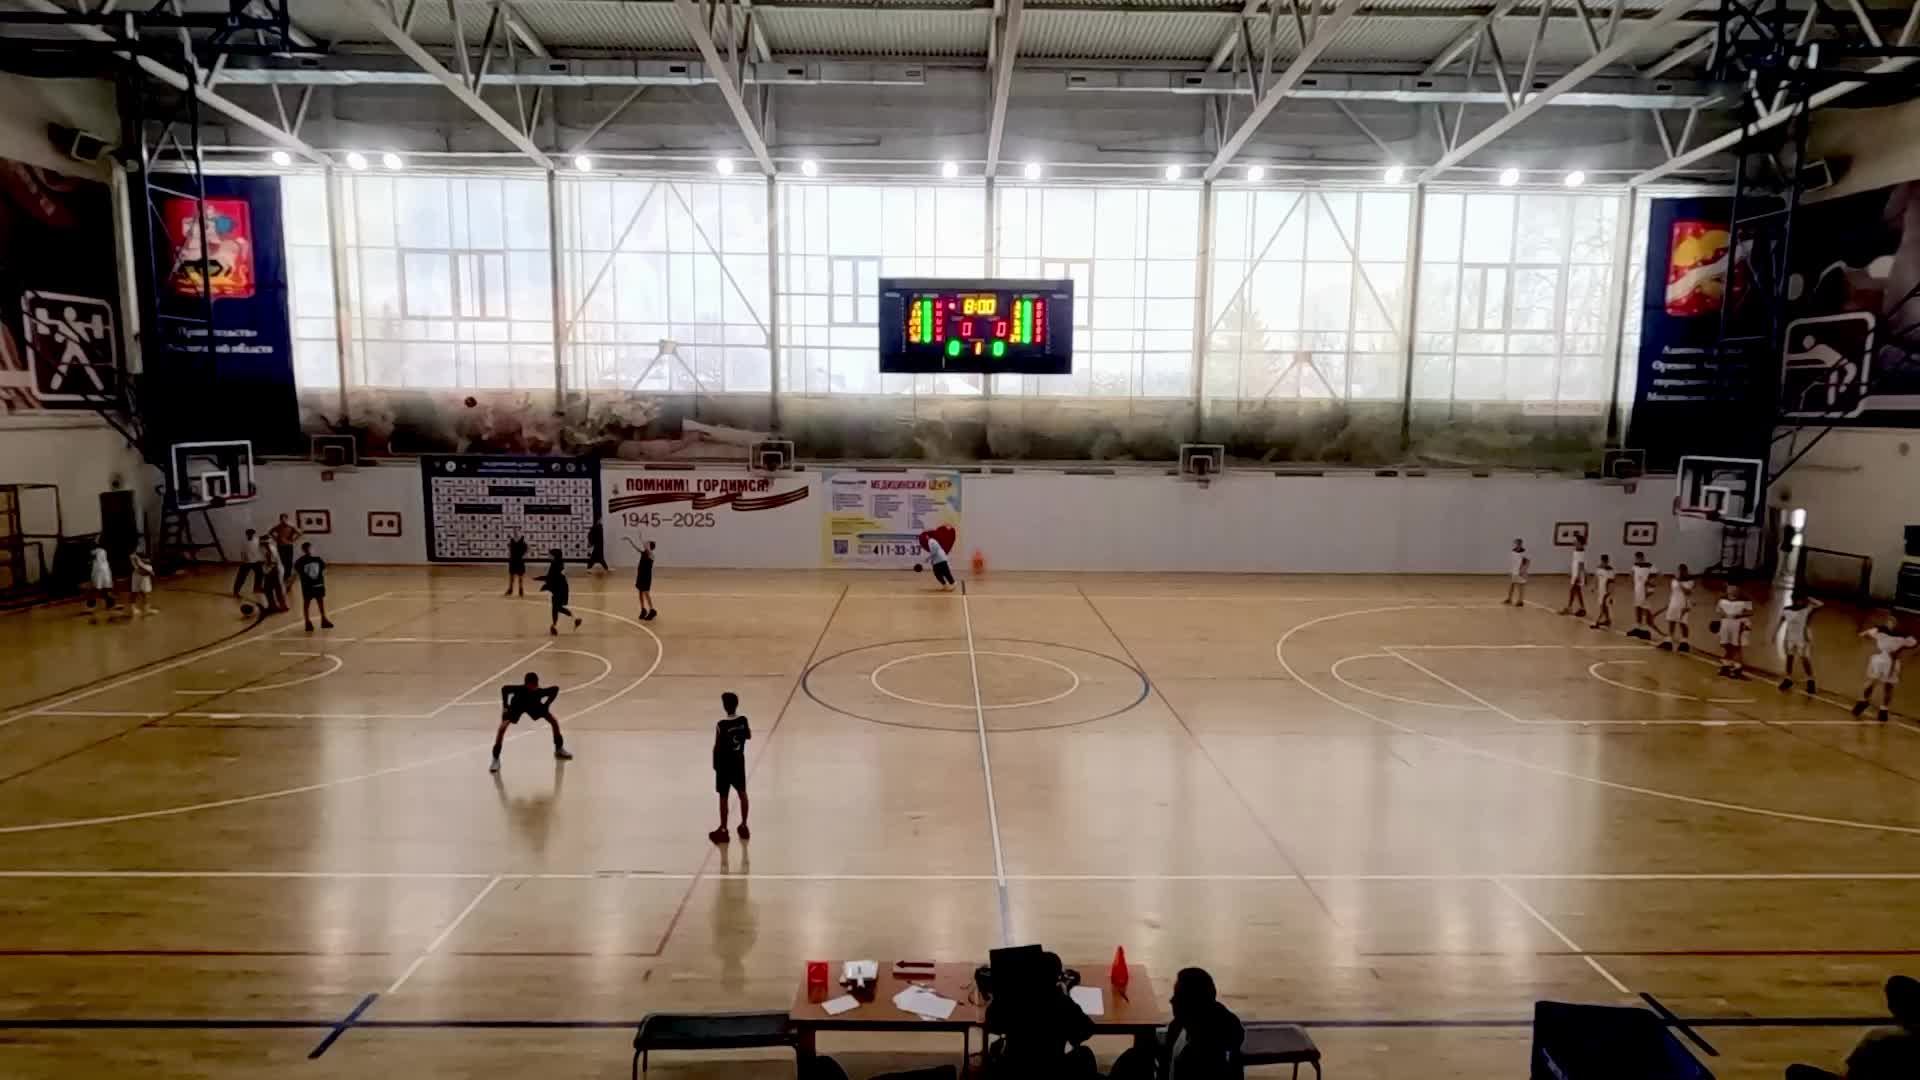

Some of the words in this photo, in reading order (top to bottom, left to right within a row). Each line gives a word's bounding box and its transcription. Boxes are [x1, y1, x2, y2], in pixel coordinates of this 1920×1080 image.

[963, 298, 996, 315] 8:00
[962, 322, 972, 336] 0
[996, 321, 1006, 337] 0
[626, 478, 689, 492] ПОМНИМ!
[622, 512, 715, 528] 1945-2025
